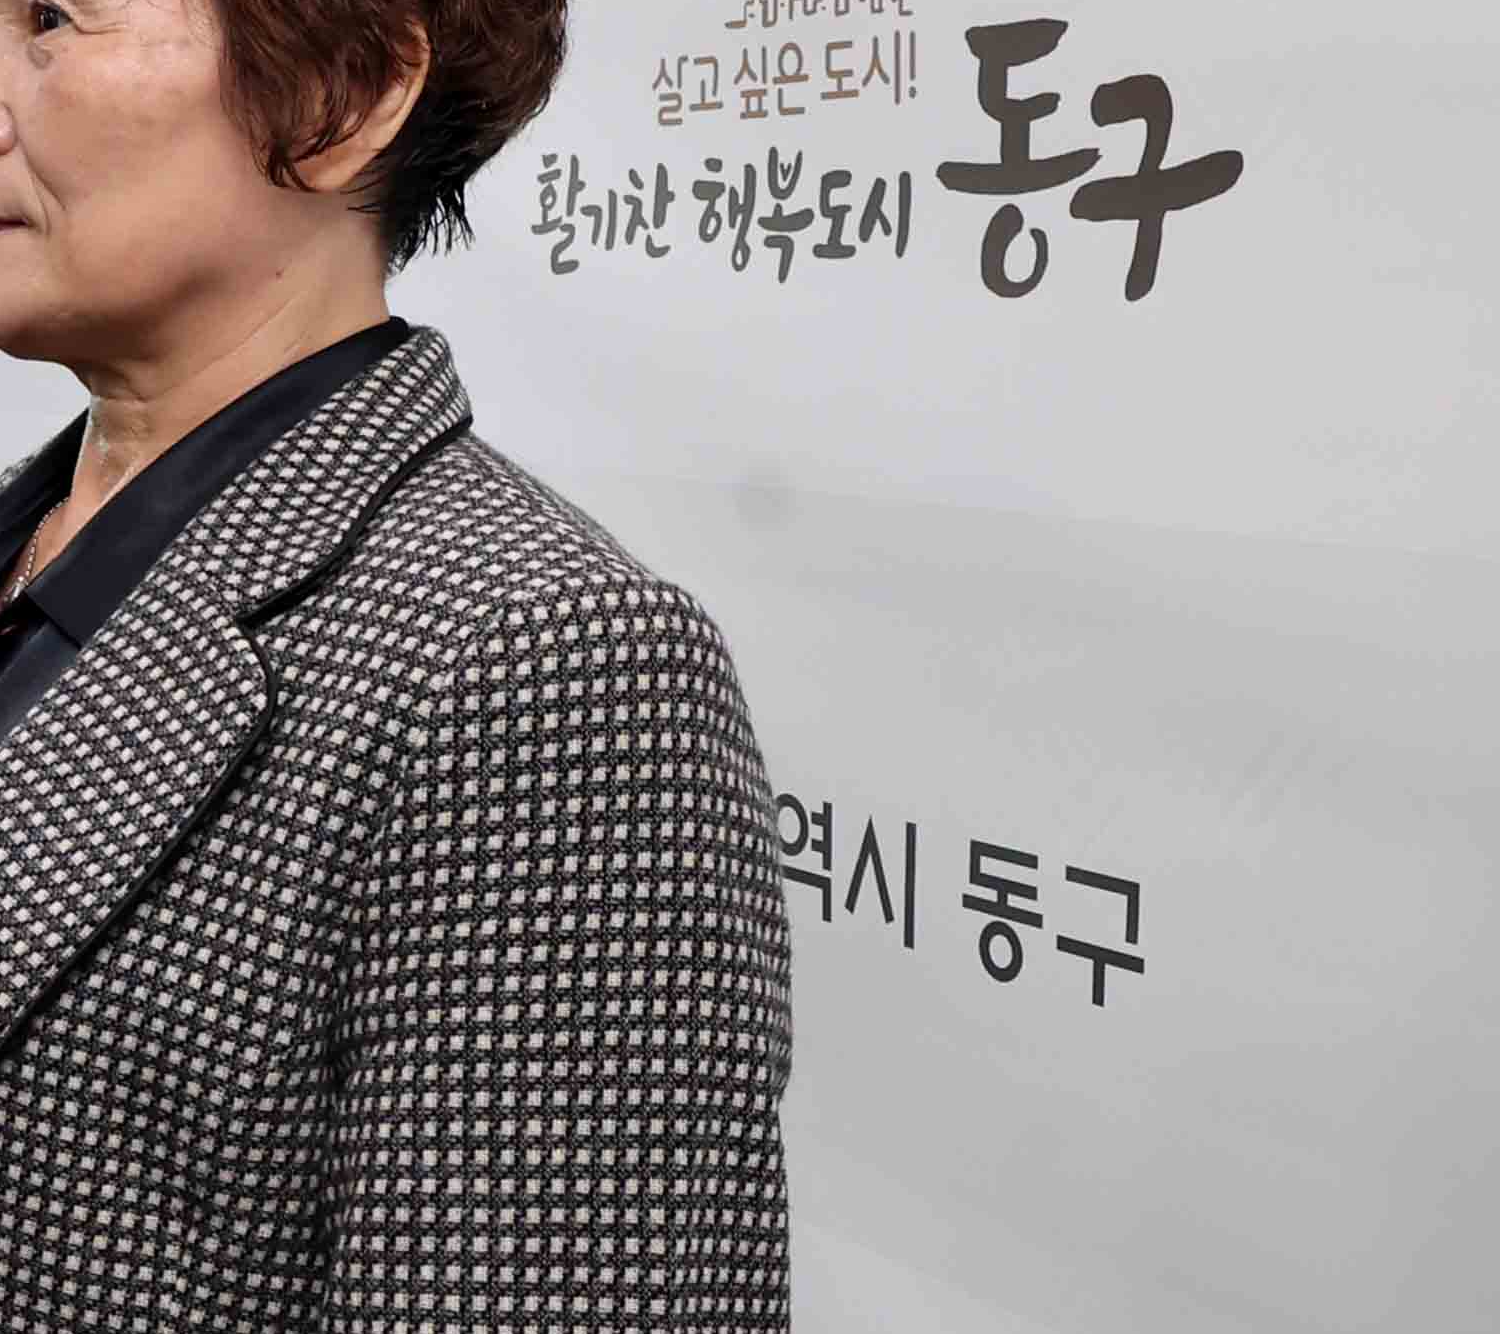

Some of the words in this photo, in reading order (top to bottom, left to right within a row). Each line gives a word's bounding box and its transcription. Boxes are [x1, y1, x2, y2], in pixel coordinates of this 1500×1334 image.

[652, 55, 724, 126] 살고
[733, 42, 810, 120] 싶은
[820, 29, 917, 105] 도시!
[531, 153, 676, 276] 활기찬
[691, 146, 912, 283] 행복도시
[935, 17, 1244, 302] 동구
[961, 838, 1145, 1008] 동구
